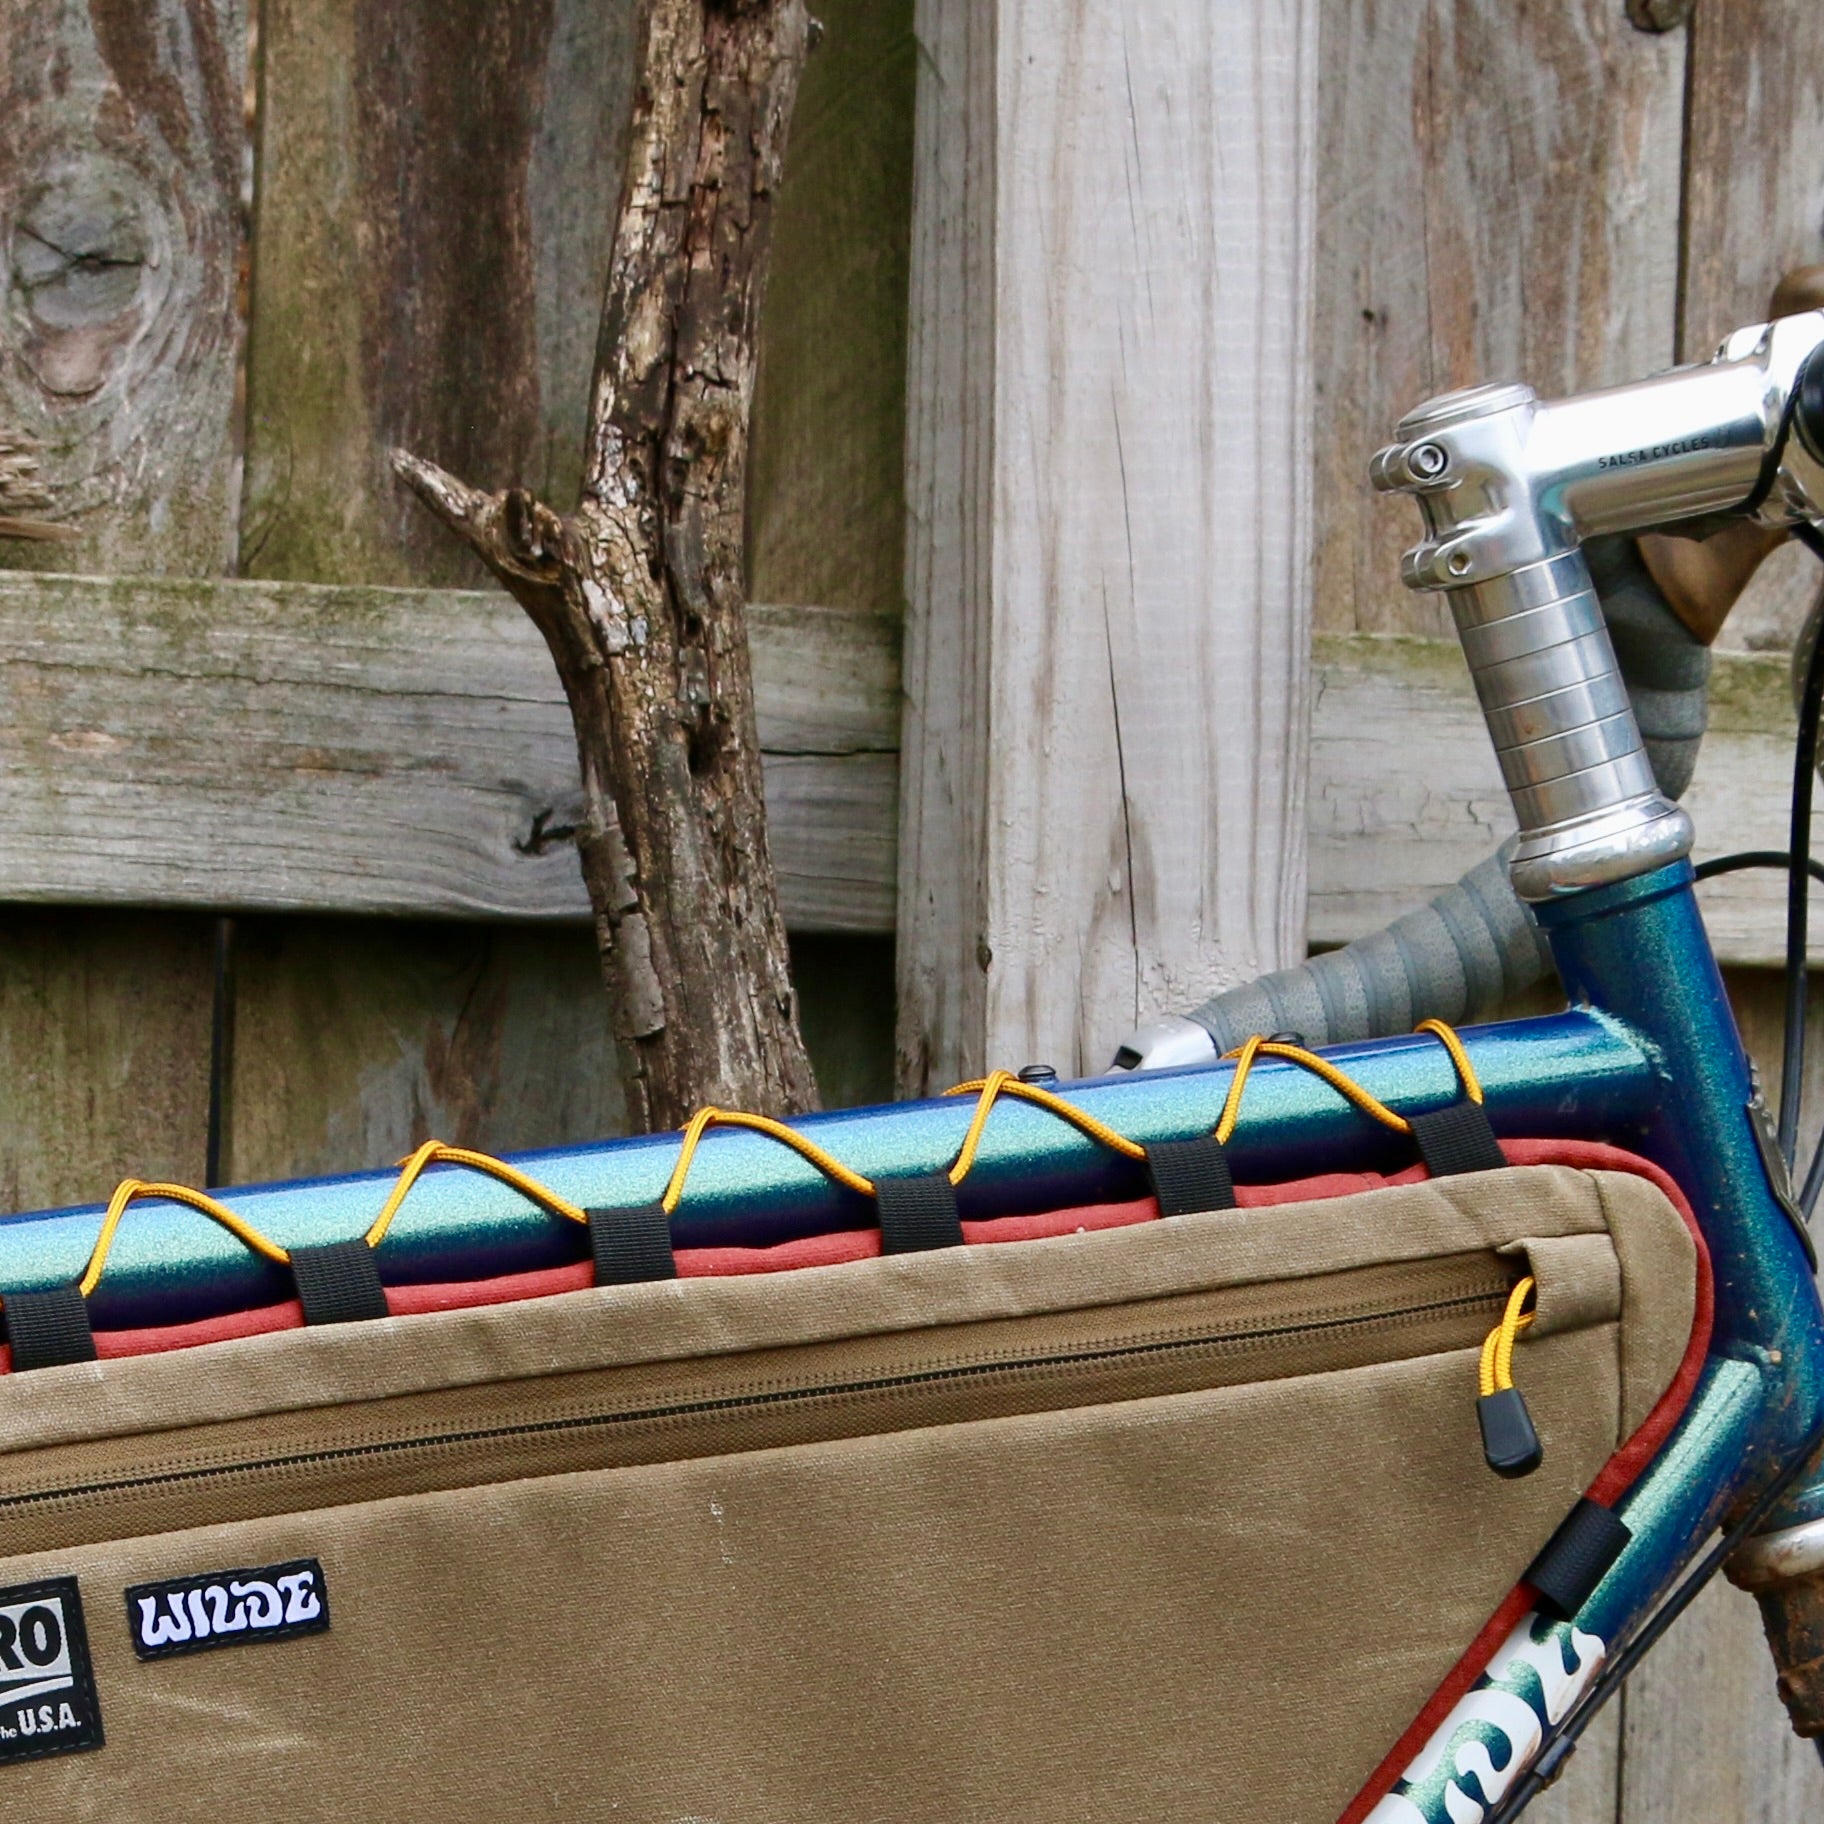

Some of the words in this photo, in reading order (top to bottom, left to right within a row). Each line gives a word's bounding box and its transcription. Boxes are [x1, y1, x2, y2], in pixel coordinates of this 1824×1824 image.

[1598, 450, 1647, 469] SALSA
[1653, 435, 1710, 459] CYCLES
[138, 1569, 322, 1647] WILDE
[17, 1702, 82, 1736] U.S.A.
